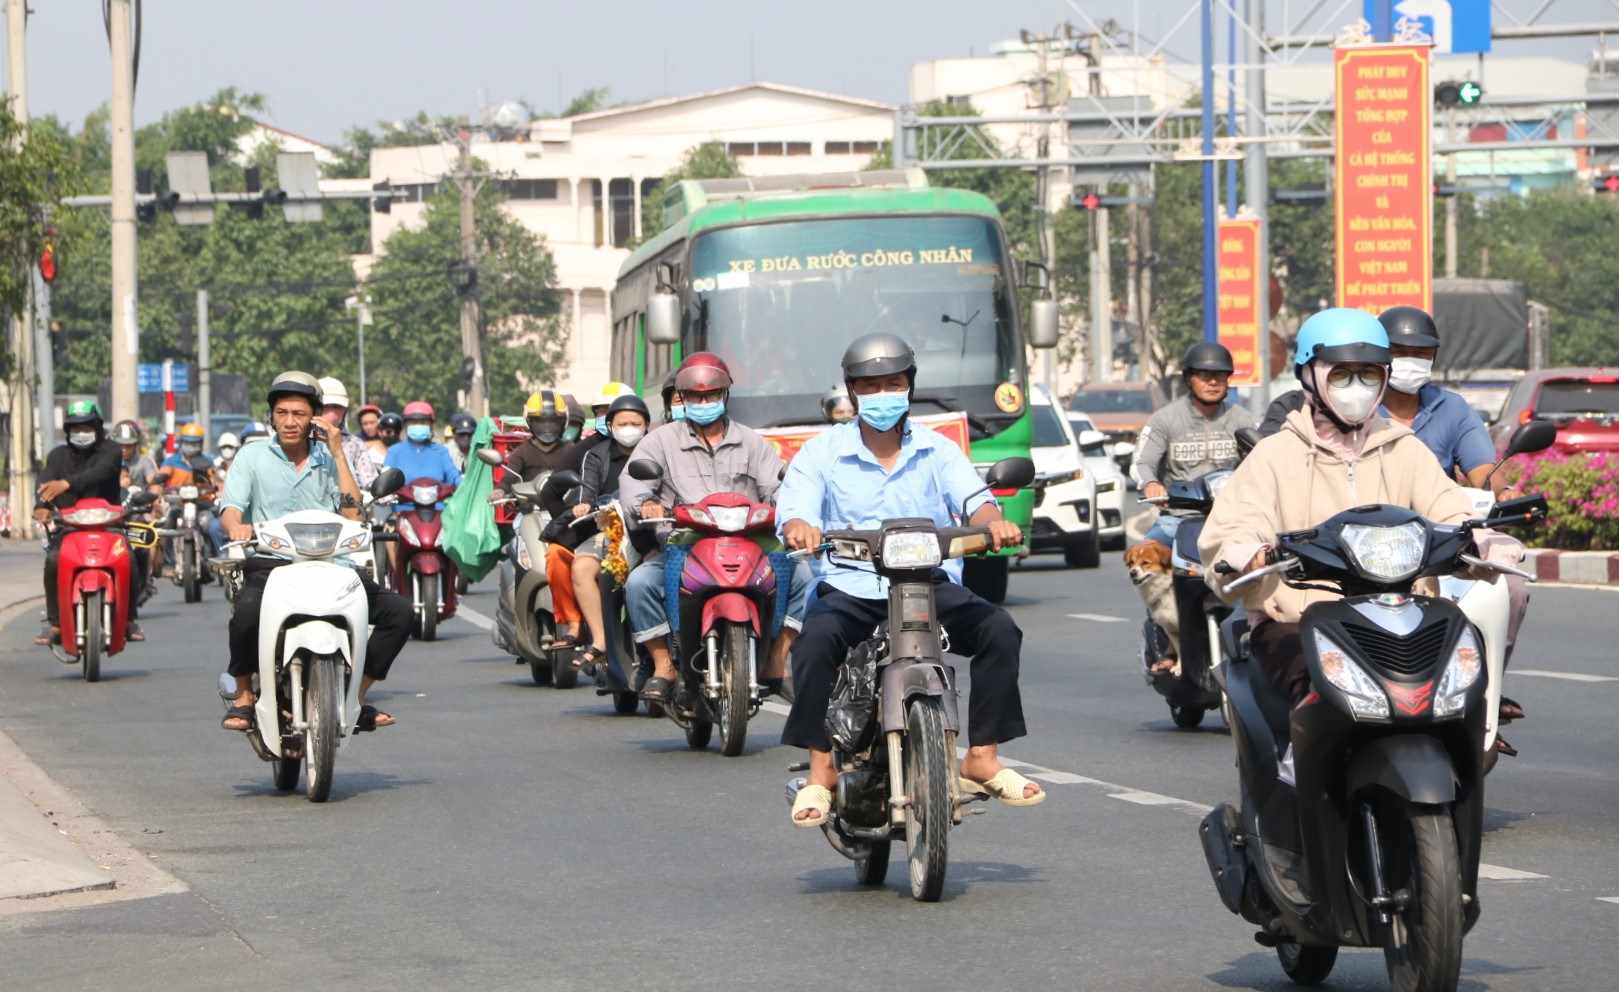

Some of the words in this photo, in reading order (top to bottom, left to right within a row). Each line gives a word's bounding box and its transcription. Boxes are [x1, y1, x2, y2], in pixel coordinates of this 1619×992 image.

[729, 259, 755, 273] XE
[762, 256, 801, 272] ĐƯA
[807, 250, 858, 270] RƯỚC
[861, 250, 914, 266] CÔNG
[919, 246, 973, 264] NHÂN
